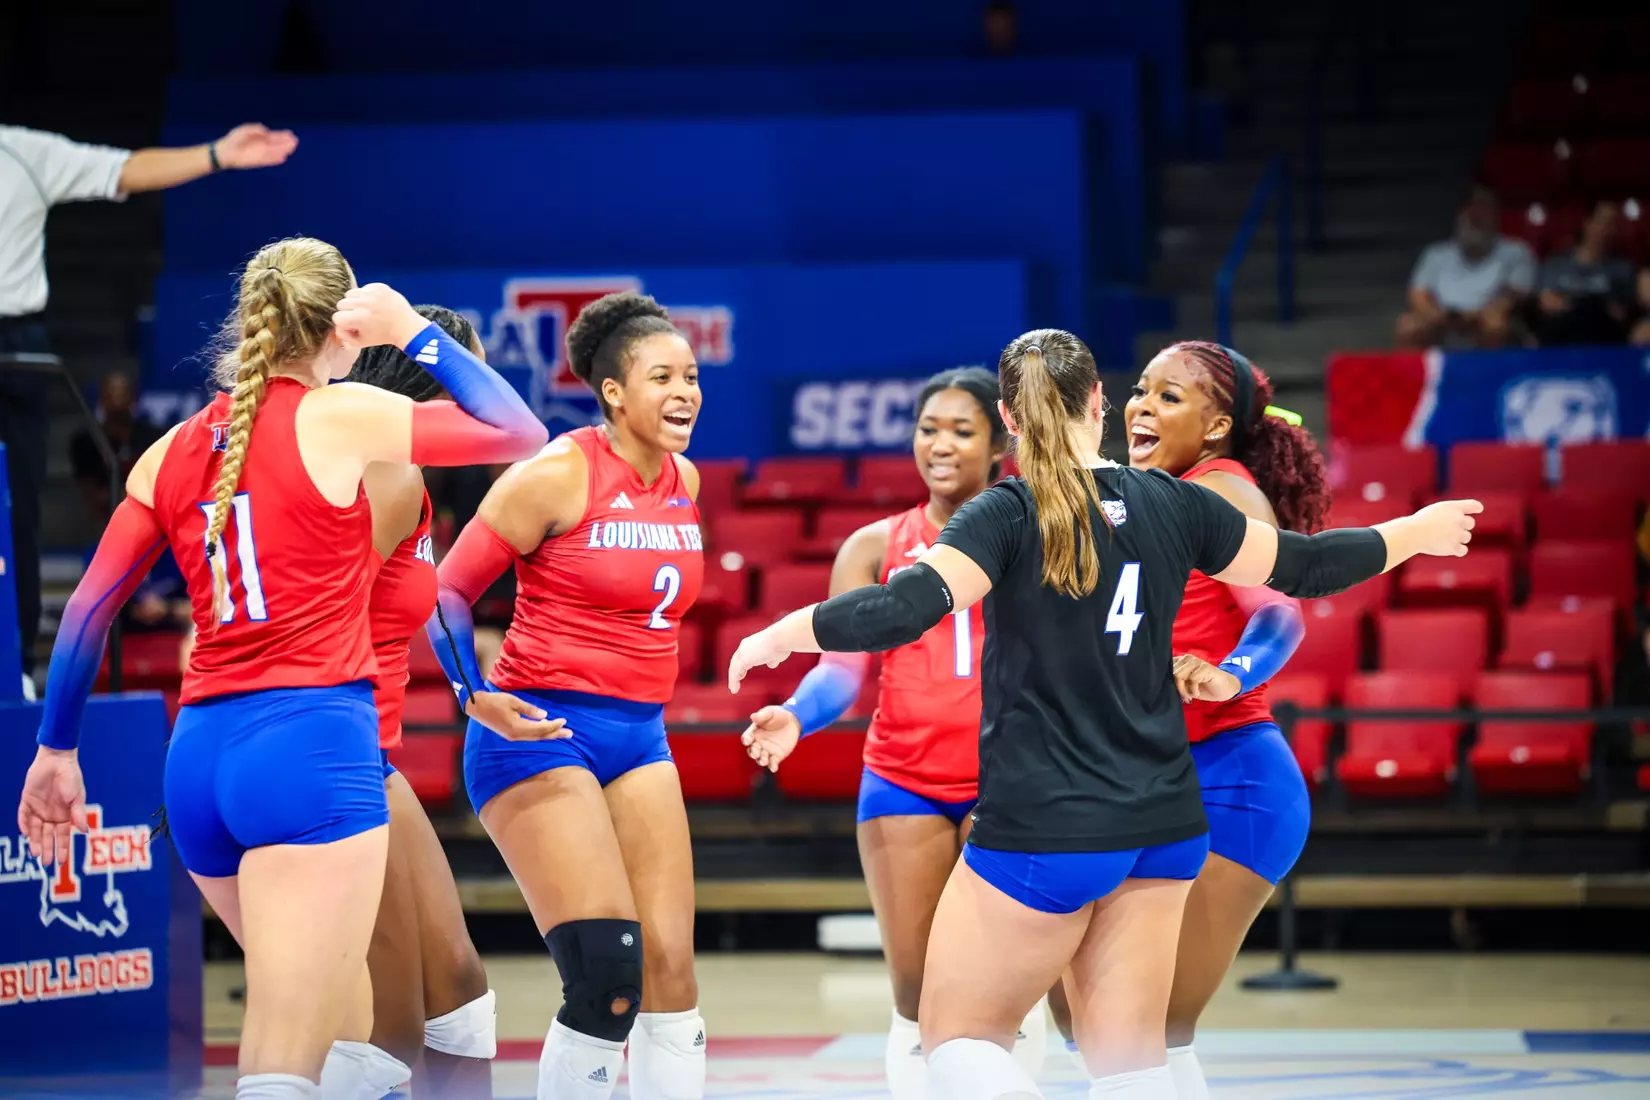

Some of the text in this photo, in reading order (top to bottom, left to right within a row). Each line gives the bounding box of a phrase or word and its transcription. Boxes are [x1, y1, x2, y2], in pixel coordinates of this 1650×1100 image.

[791, 379, 927, 450] SEC
[197, 491, 269, 624] 11
[587, 521, 682, 551] LOUISIANA
[646, 563, 682, 630] 2
[1104, 561, 1145, 656] 4
[0, 948, 153, 1005] BULLDOGS
